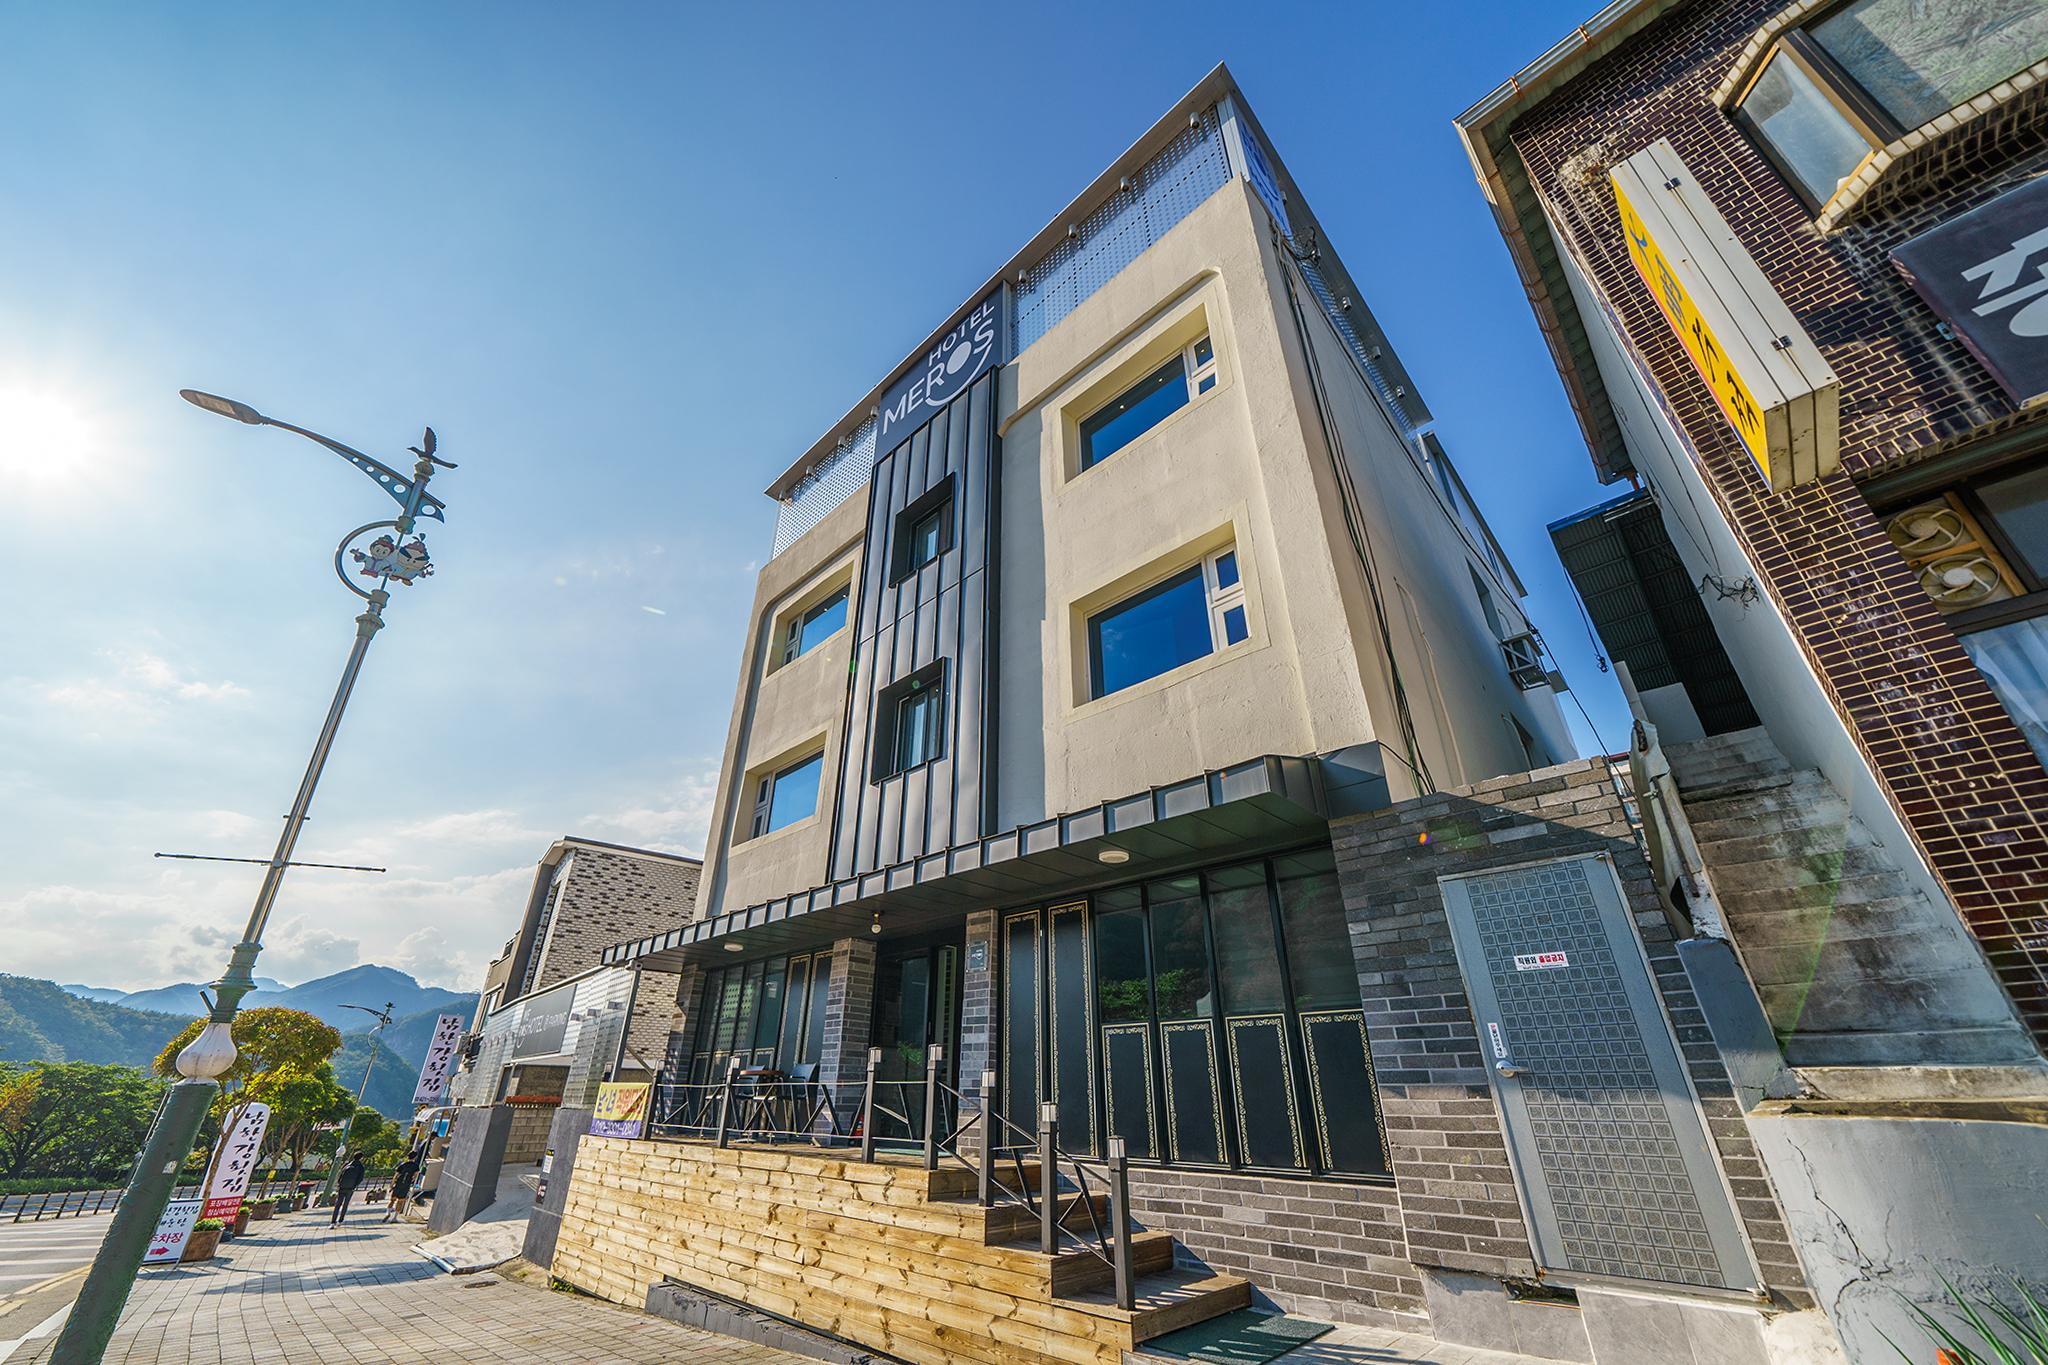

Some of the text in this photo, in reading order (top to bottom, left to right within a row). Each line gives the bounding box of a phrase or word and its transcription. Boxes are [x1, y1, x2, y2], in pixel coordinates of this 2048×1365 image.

[928, 301, 995, 367] HOTEL
[882, 318, 994, 435] MEROS
[1539, 953, 1565, 963] 출입금지
[423, 1017, 460, 1092] 남한강횟집
[222, 1110, 265, 1193] 남한강횟집
